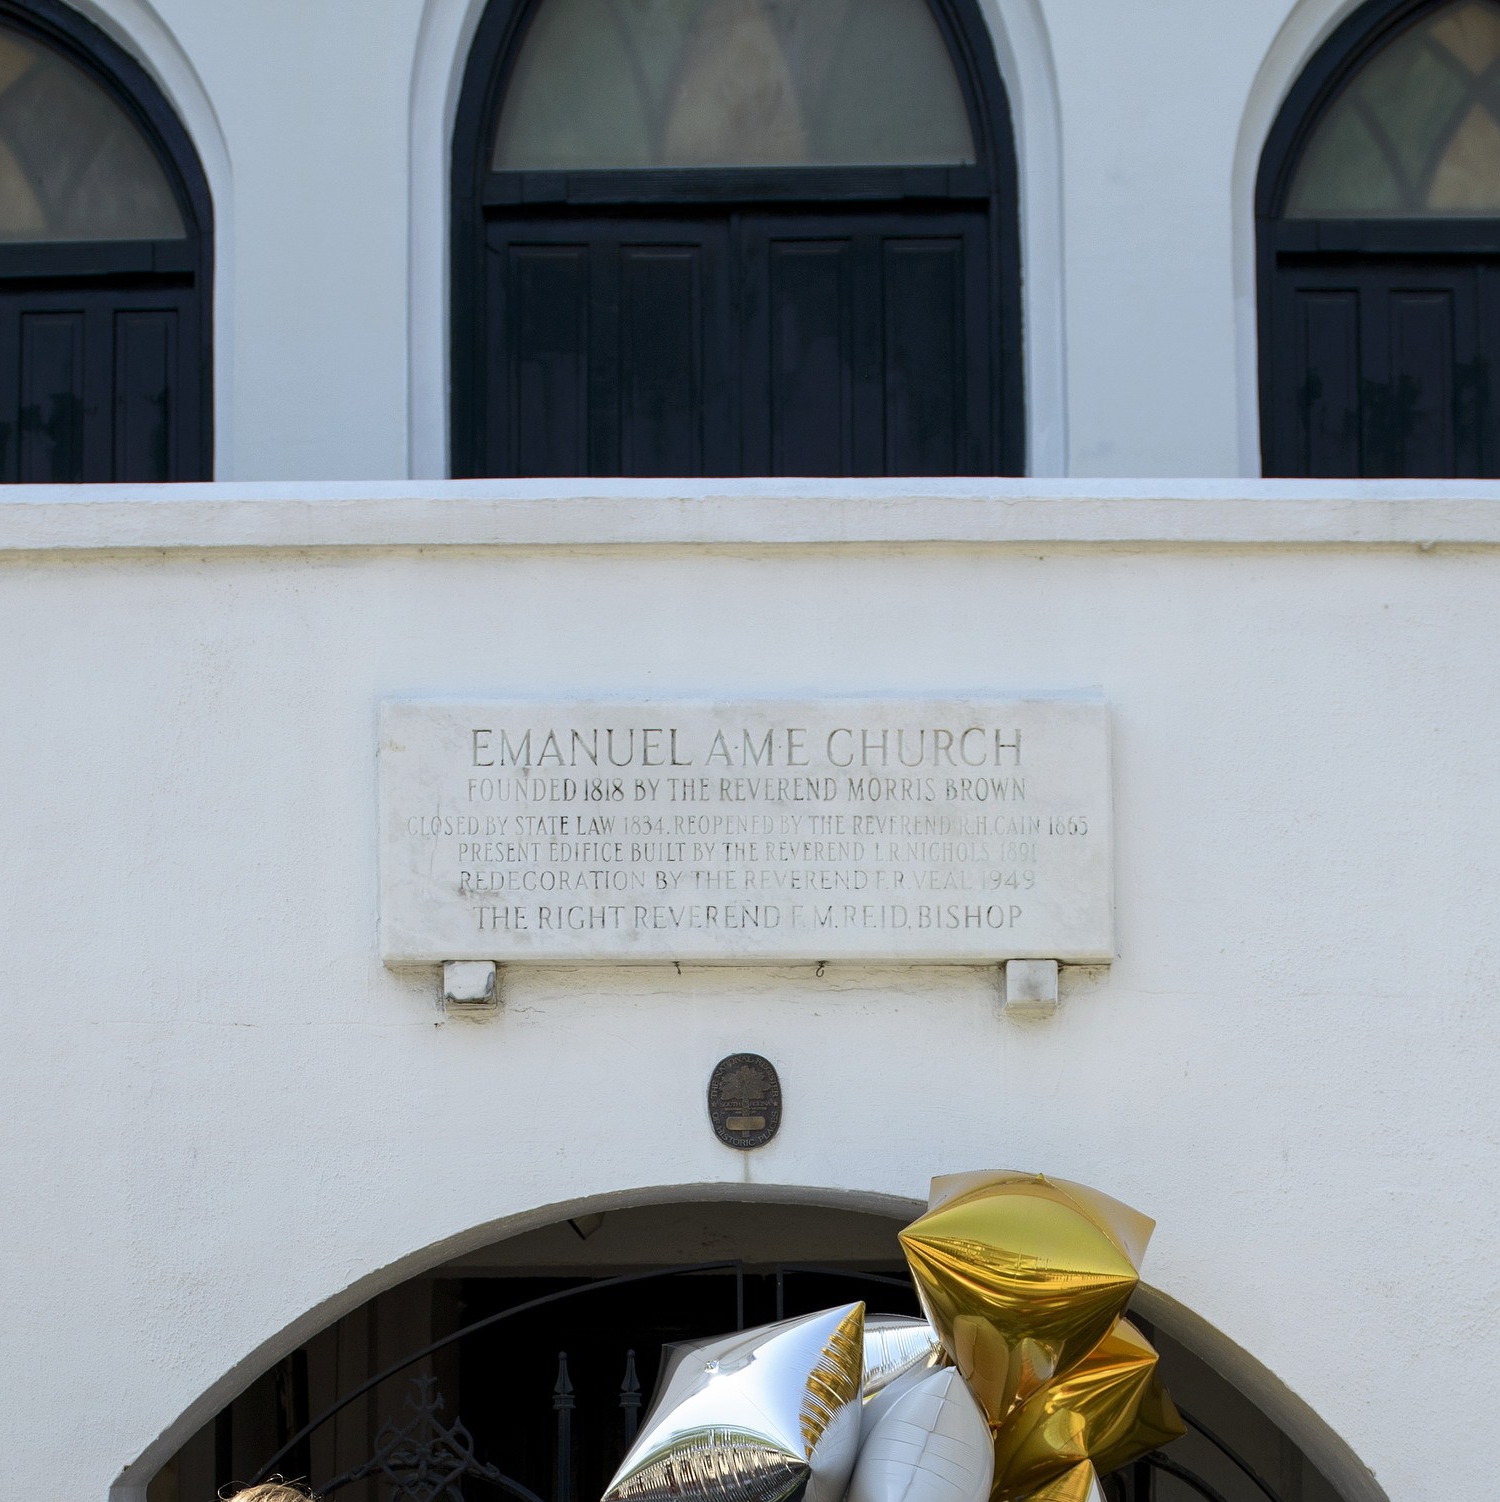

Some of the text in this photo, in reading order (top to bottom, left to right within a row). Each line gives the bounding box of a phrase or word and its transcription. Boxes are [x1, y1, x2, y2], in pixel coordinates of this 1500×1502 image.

[471, 728, 694, 767] EMANUEL
[826, 728, 1023, 767] CHURCH
[467, 777, 1027, 802] FOUNDED 1818 BY THE REVEREND MORRIS BROWN
[406, 814, 480, 836] CLOSED
[485, 814, 510, 836] BY
[514, 814, 569, 836] STATE
[576, 814, 617, 836] LAW
[779, 814, 803, 836] BY
[808, 814, 846, 836] THE
[852, 814, 953, 836] REVEREND
[1048, 814, 1089, 836] 1865
[457, 842, 540, 863] PRESENT
[548, 842, 623, 863] EDIFICE
[630, 842, 686, 863] BUILT
[692, 842, 717, 863] BY
[722, 842, 759, 863] THE
[765, 842, 866, 863] REVEREND
[999, 842, 1038, 863] 1891
[459, 870, 646, 891] REDECORATION
[655, 870, 685, 891] BY
[690, 870, 738, 891] THE
[744, 870, 869, 891] REVEREND
[981, 870, 1037, 891] 1949
[472, 904, 529, 931] THE
[537, 904, 627, 931] RIGHT
[633, 904, 781, 931] REVEREND
[917, 904, 1024, 931] BISHOP
[714, 1055, 756, 1080] NATIONAL
[754, 1056, 780, 1099] REGISTER
[715, 1125, 756, 1147] HISTORIC
[756, 1110, 779, 1144] PLACES
